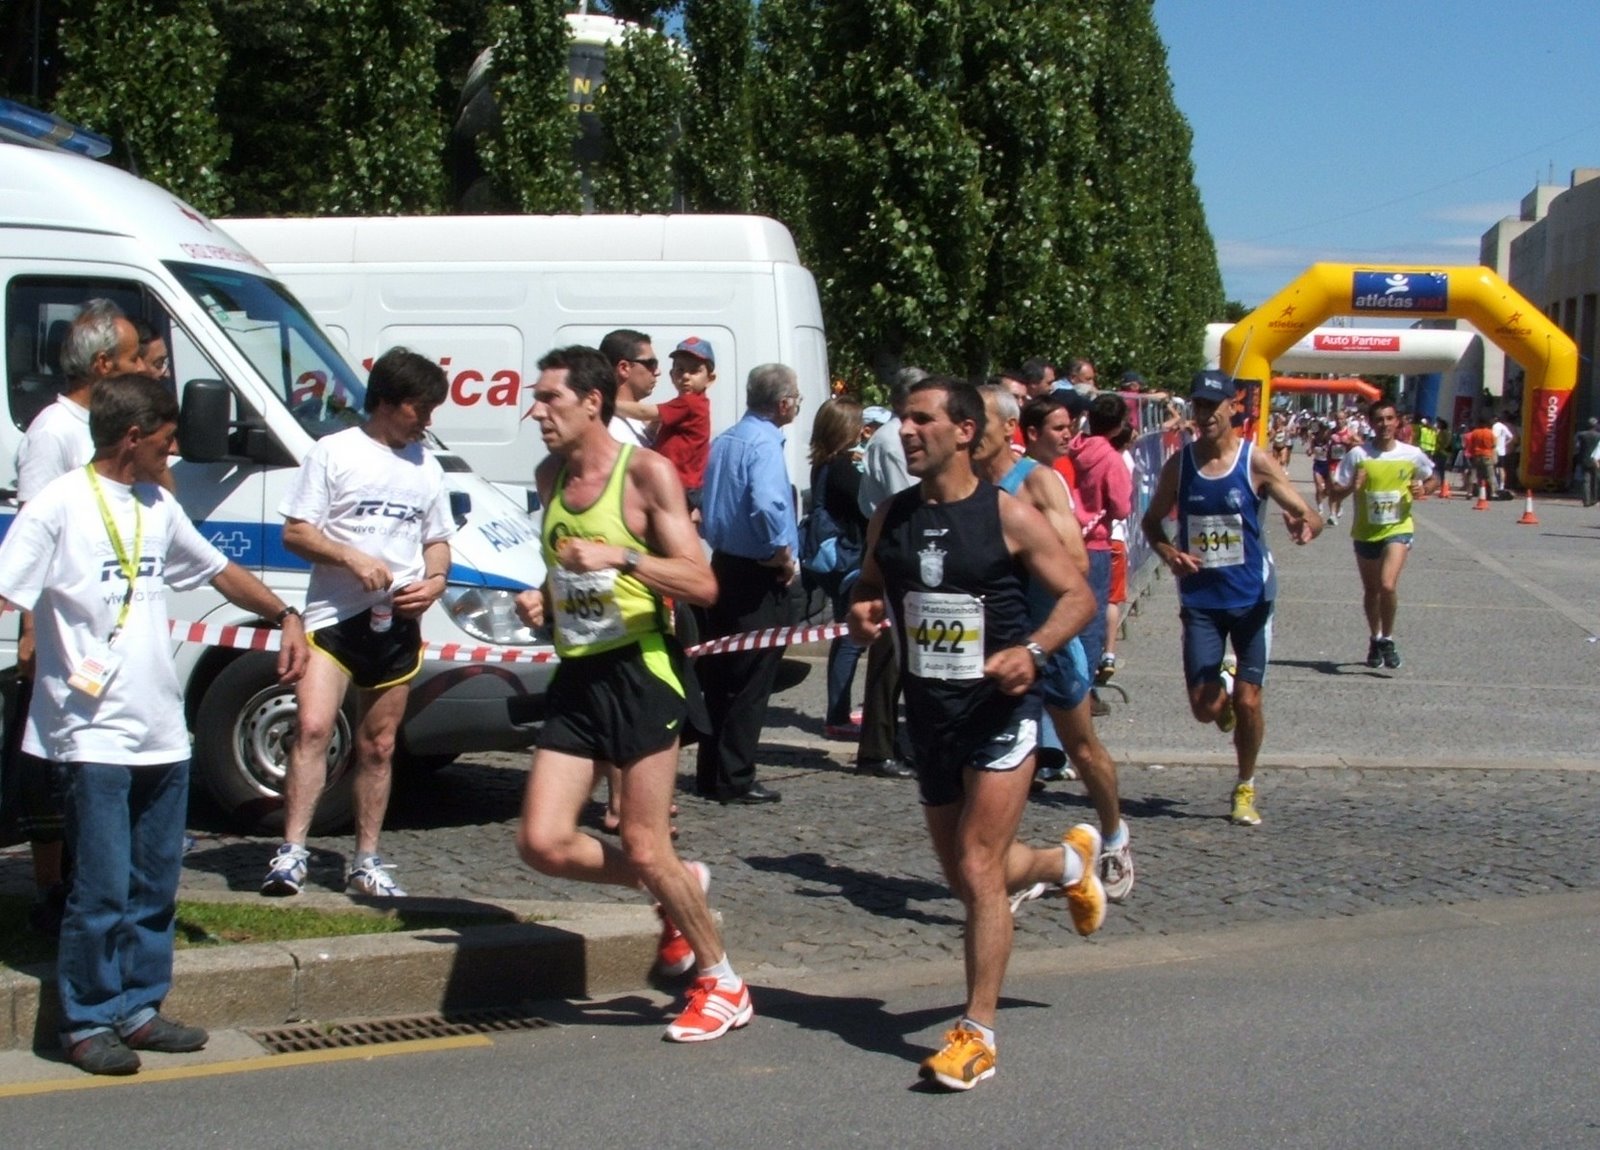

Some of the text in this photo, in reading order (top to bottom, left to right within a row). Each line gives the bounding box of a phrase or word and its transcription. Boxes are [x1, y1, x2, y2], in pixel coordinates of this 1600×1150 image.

[1322, 334, 1392, 346] Auto Partner
[1374, 500, 1394, 515] 277
[1199, 530, 1229, 552] 331
[916, 618, 965, 654] 422
